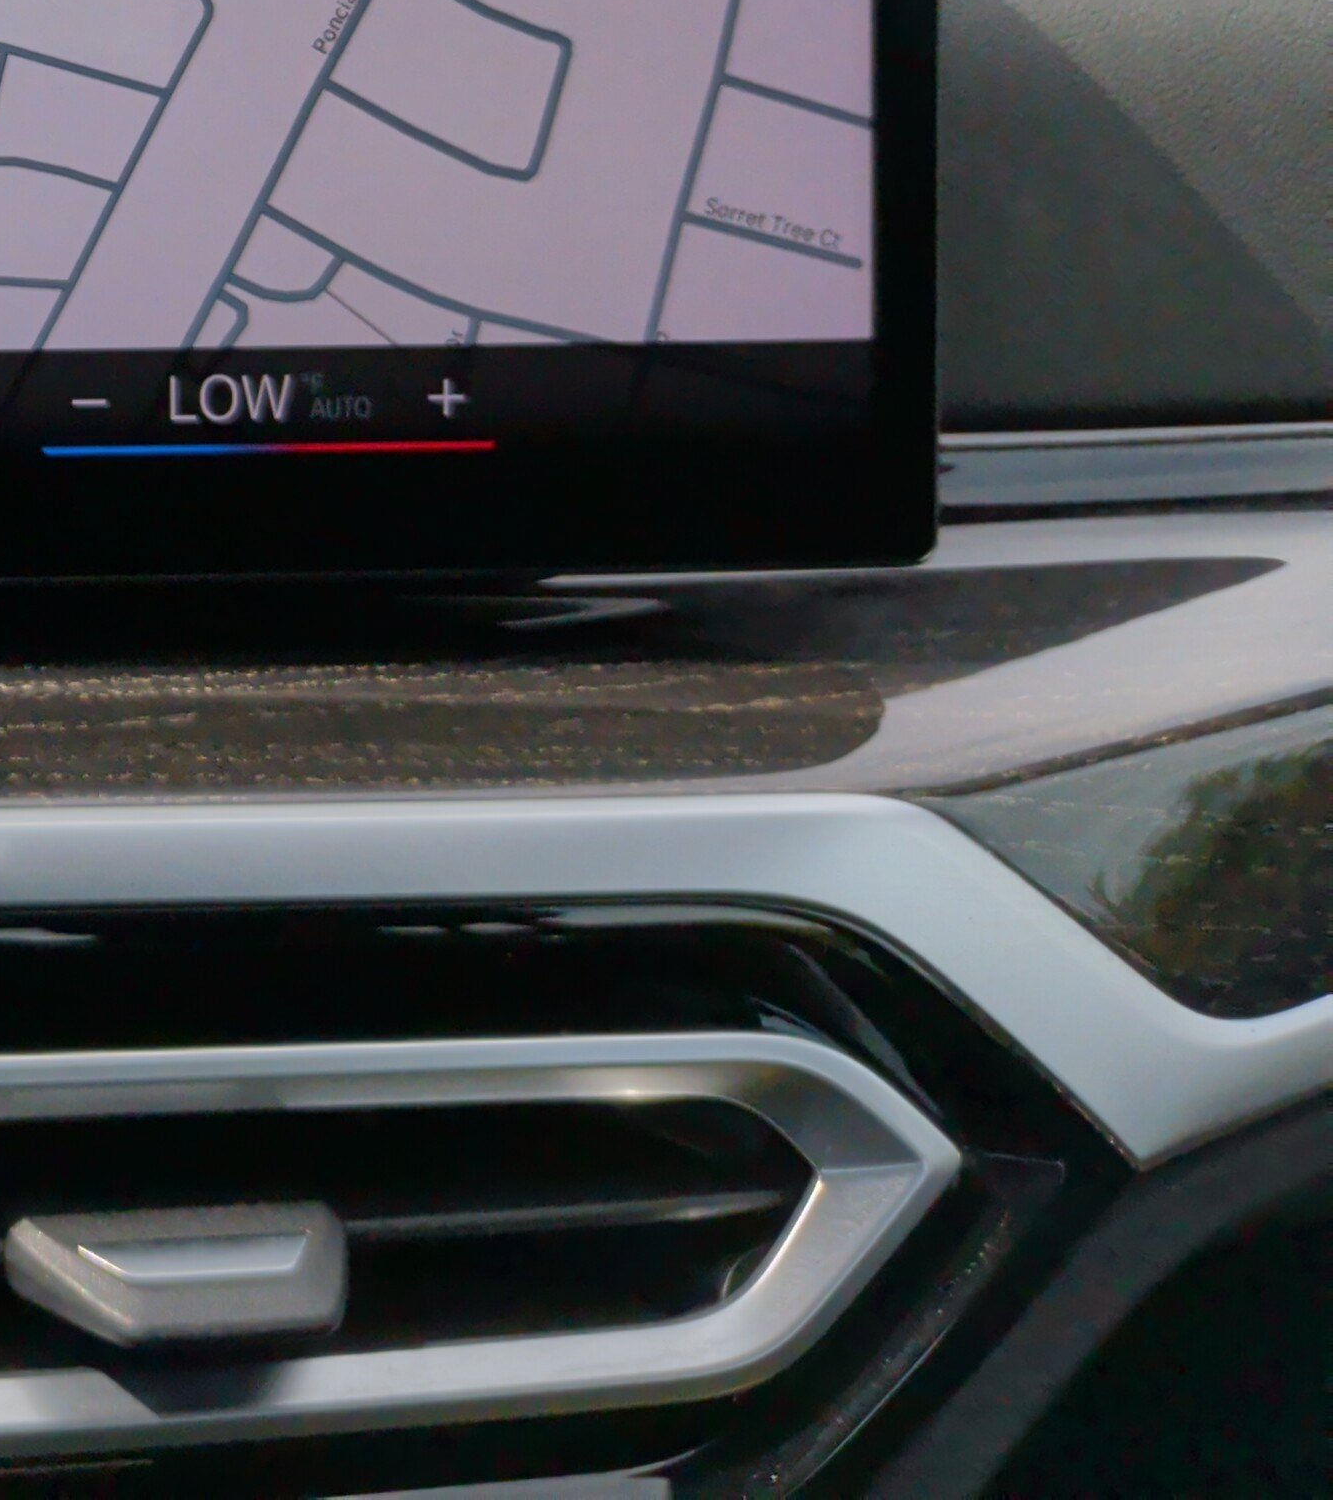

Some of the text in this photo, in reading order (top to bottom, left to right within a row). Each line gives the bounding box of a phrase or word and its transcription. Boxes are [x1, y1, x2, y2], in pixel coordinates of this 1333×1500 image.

[772, 215, 816, 242] Tree
[169, 373, 293, 423] LOW
[309, 395, 373, 419] AUTO
